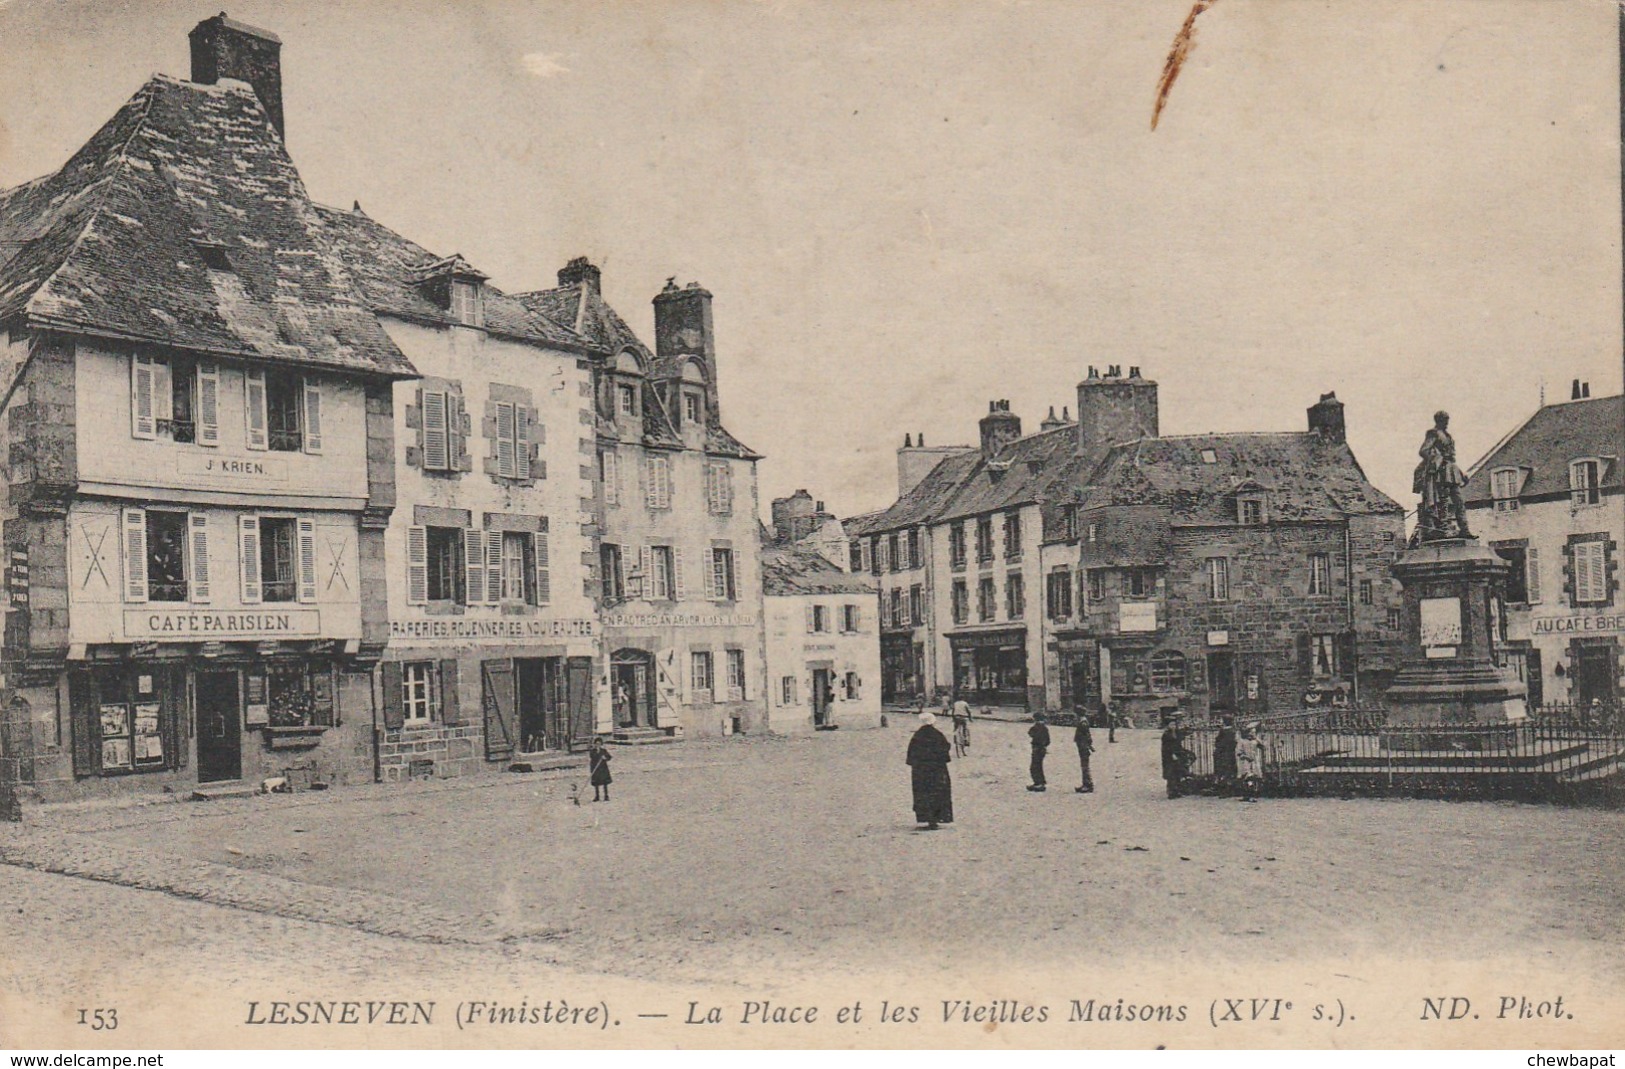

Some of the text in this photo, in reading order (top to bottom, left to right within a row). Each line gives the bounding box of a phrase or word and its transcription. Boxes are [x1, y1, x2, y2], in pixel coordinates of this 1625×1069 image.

[222, 460, 268, 475] KRIEN.
[149, 611, 296, 631] CAFÉ PARISIEN.
[1535, 619, 1553, 632] AU
[1596, 615, 1625, 629] BRE
